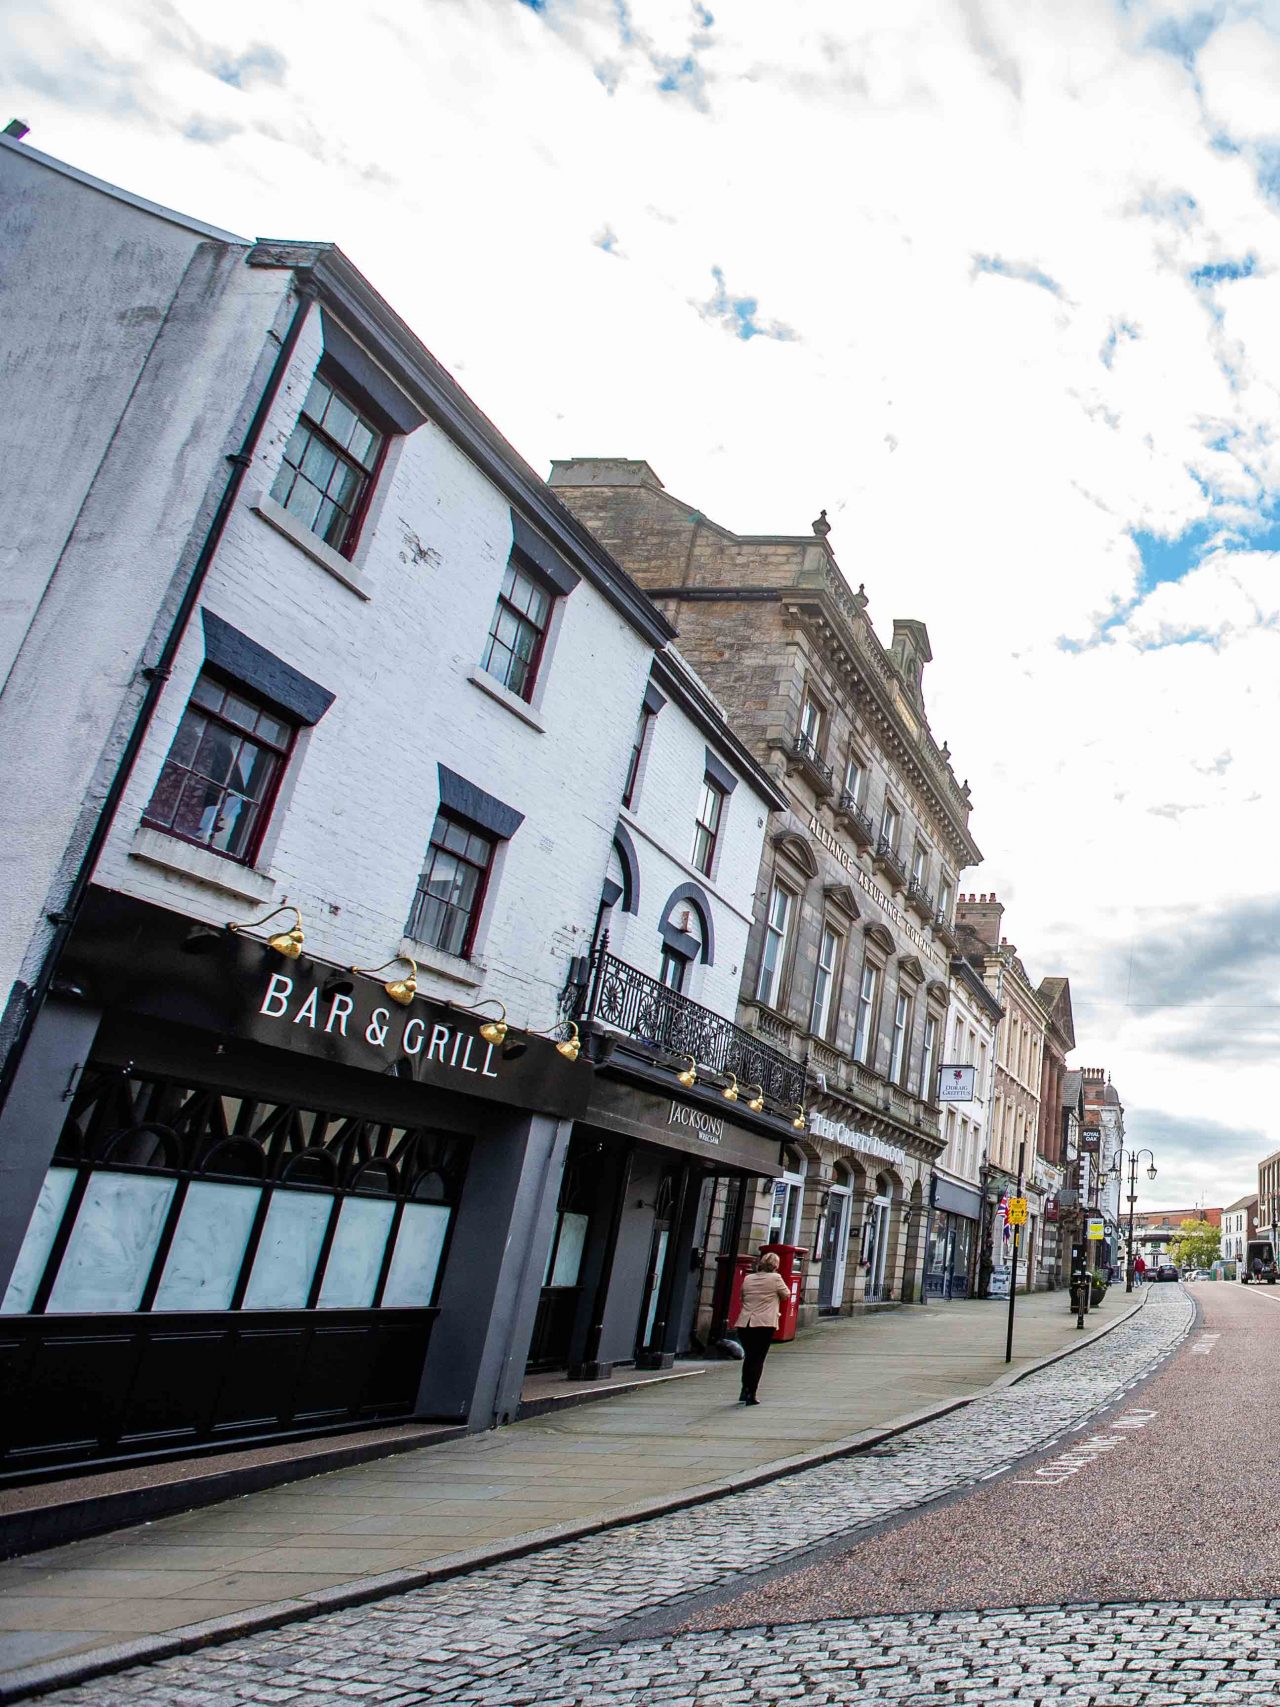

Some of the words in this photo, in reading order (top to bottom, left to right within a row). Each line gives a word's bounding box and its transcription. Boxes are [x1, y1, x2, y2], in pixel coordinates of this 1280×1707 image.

[810, 816, 853, 873] ALLIANCE
[859, 871, 902, 927] ASSURANCE
[906, 923, 935, 960] COMPANY
[259, 973, 354, 1037] BAR
[365, 1007, 390, 1047] &
[403, 1018, 498, 1077] GRILL
[667, 1100, 723, 1137] JACKSONS
[809, 1112, 835, 1141] THE
